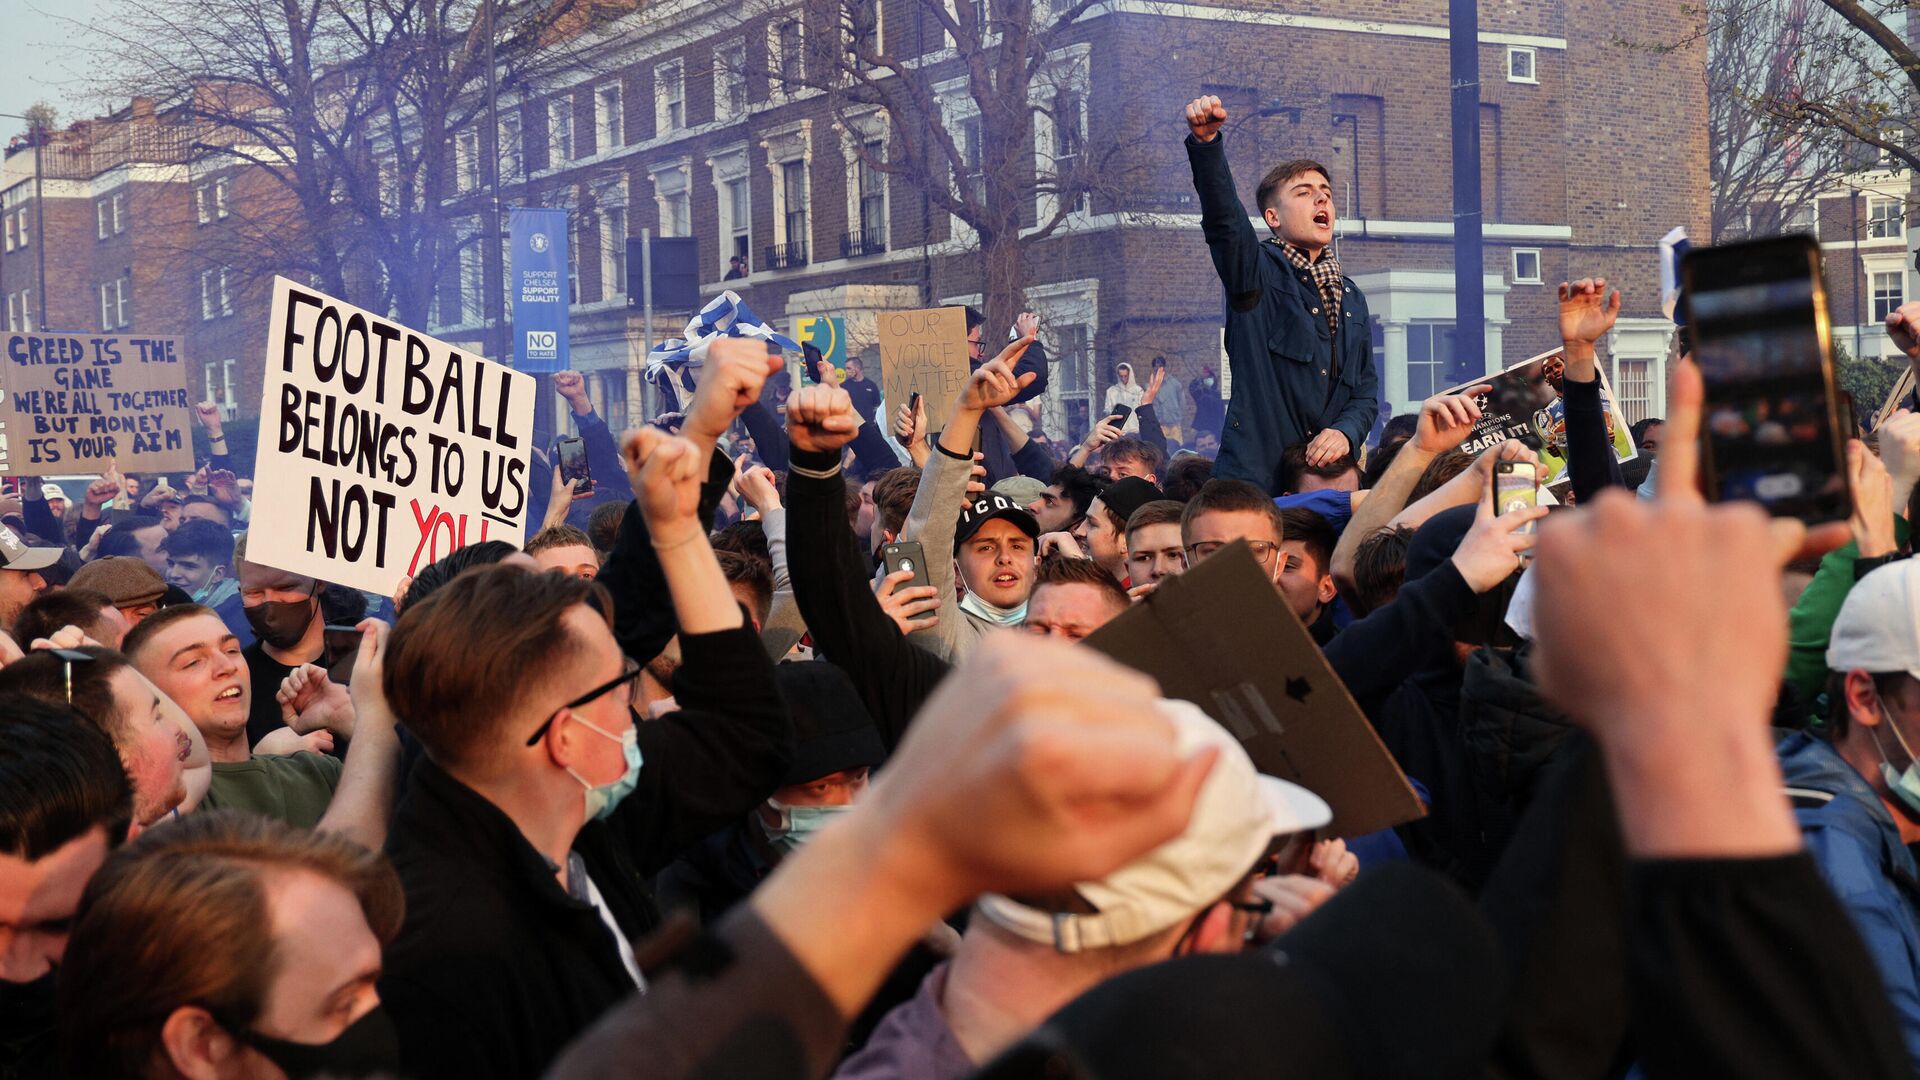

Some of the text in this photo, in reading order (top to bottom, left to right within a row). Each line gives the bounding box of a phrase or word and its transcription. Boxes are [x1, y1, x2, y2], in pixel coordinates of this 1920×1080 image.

[522, 287, 559, 295] SUPPORT
[523, 278, 558, 287] CHELSEA
[521, 294, 560, 303] EQUALITY
[889, 312, 941, 337] OUR
[8, 335, 177, 366] GREED IS THE
[529, 334, 554, 347] NO
[283, 288, 518, 450] FOOTBALL
[884, 342, 955, 370] VOICE
[54, 367, 113, 391] GAME
[886, 369, 970, 399] MATTER
[13, 386, 188, 415] WE'RE ALL TOGETHER
[34, 413, 164, 435] BUT MONEY
[1472, 414, 1511, 431] HAMPIONS
[28, 428, 182, 464] IS YOUR AIM
[278, 383, 526, 519] BELONGS TO US
[1460, 423, 1530, 455] EARN IT!
[306, 476, 396, 569] NOT
